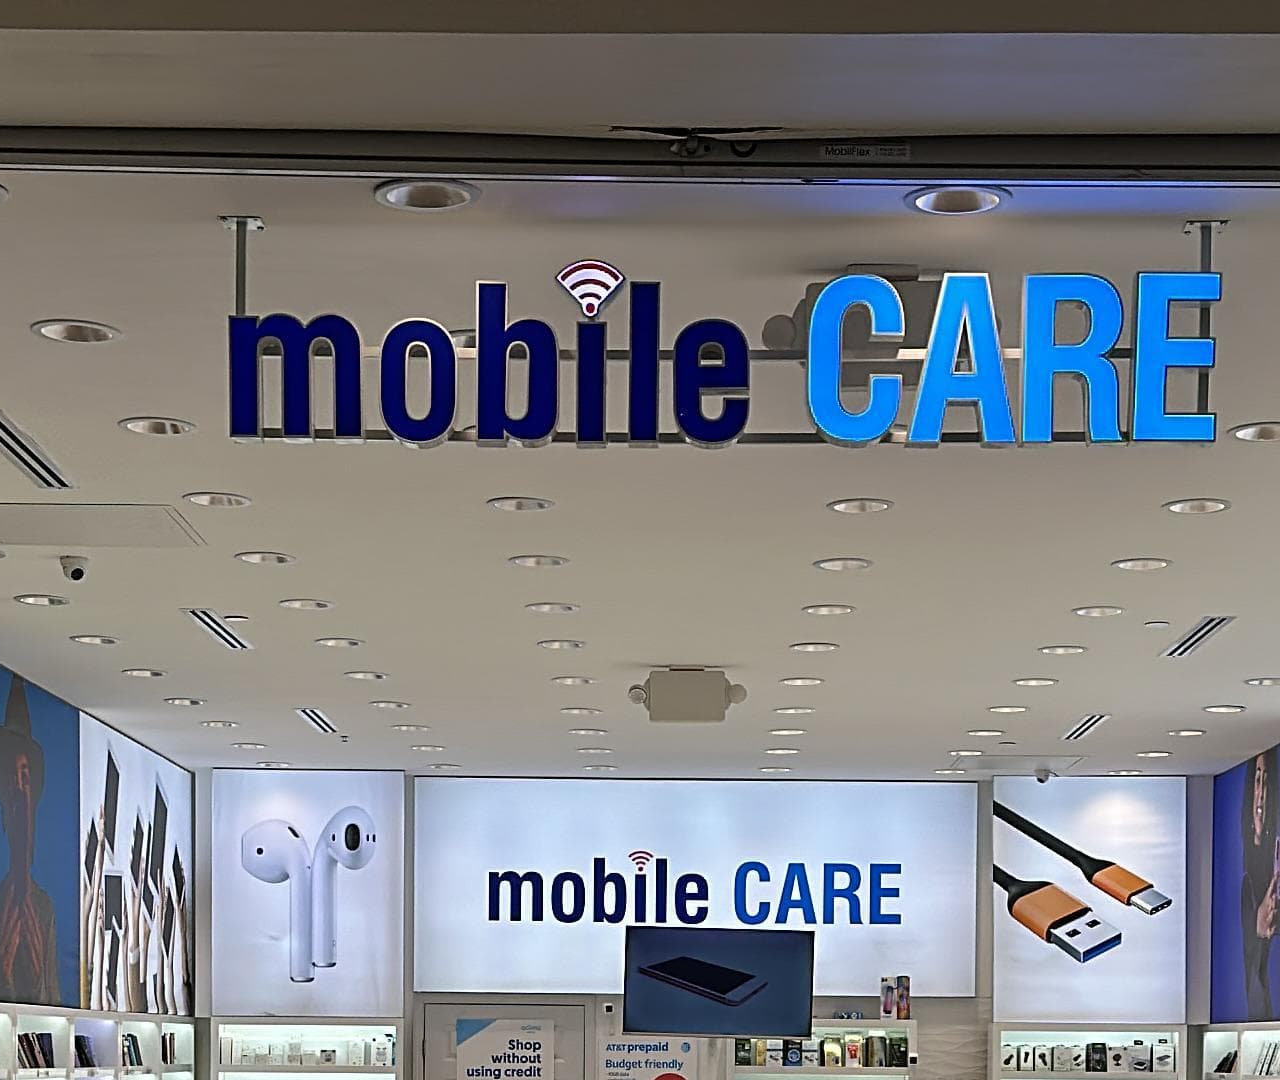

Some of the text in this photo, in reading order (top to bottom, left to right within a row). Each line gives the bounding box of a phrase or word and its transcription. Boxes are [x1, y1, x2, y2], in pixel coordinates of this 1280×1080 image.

[228, 271, 1223, 444] mobile CARE
[487, 856, 903, 926] mobile CARE
[508, 1039, 542, 1053] Shop
[627, 1042, 669, 1053] prepaid
[491, 1052, 542, 1064] without
[605, 1059, 684, 1071] Budget friendly
[466, 1065, 502, 1080] using
